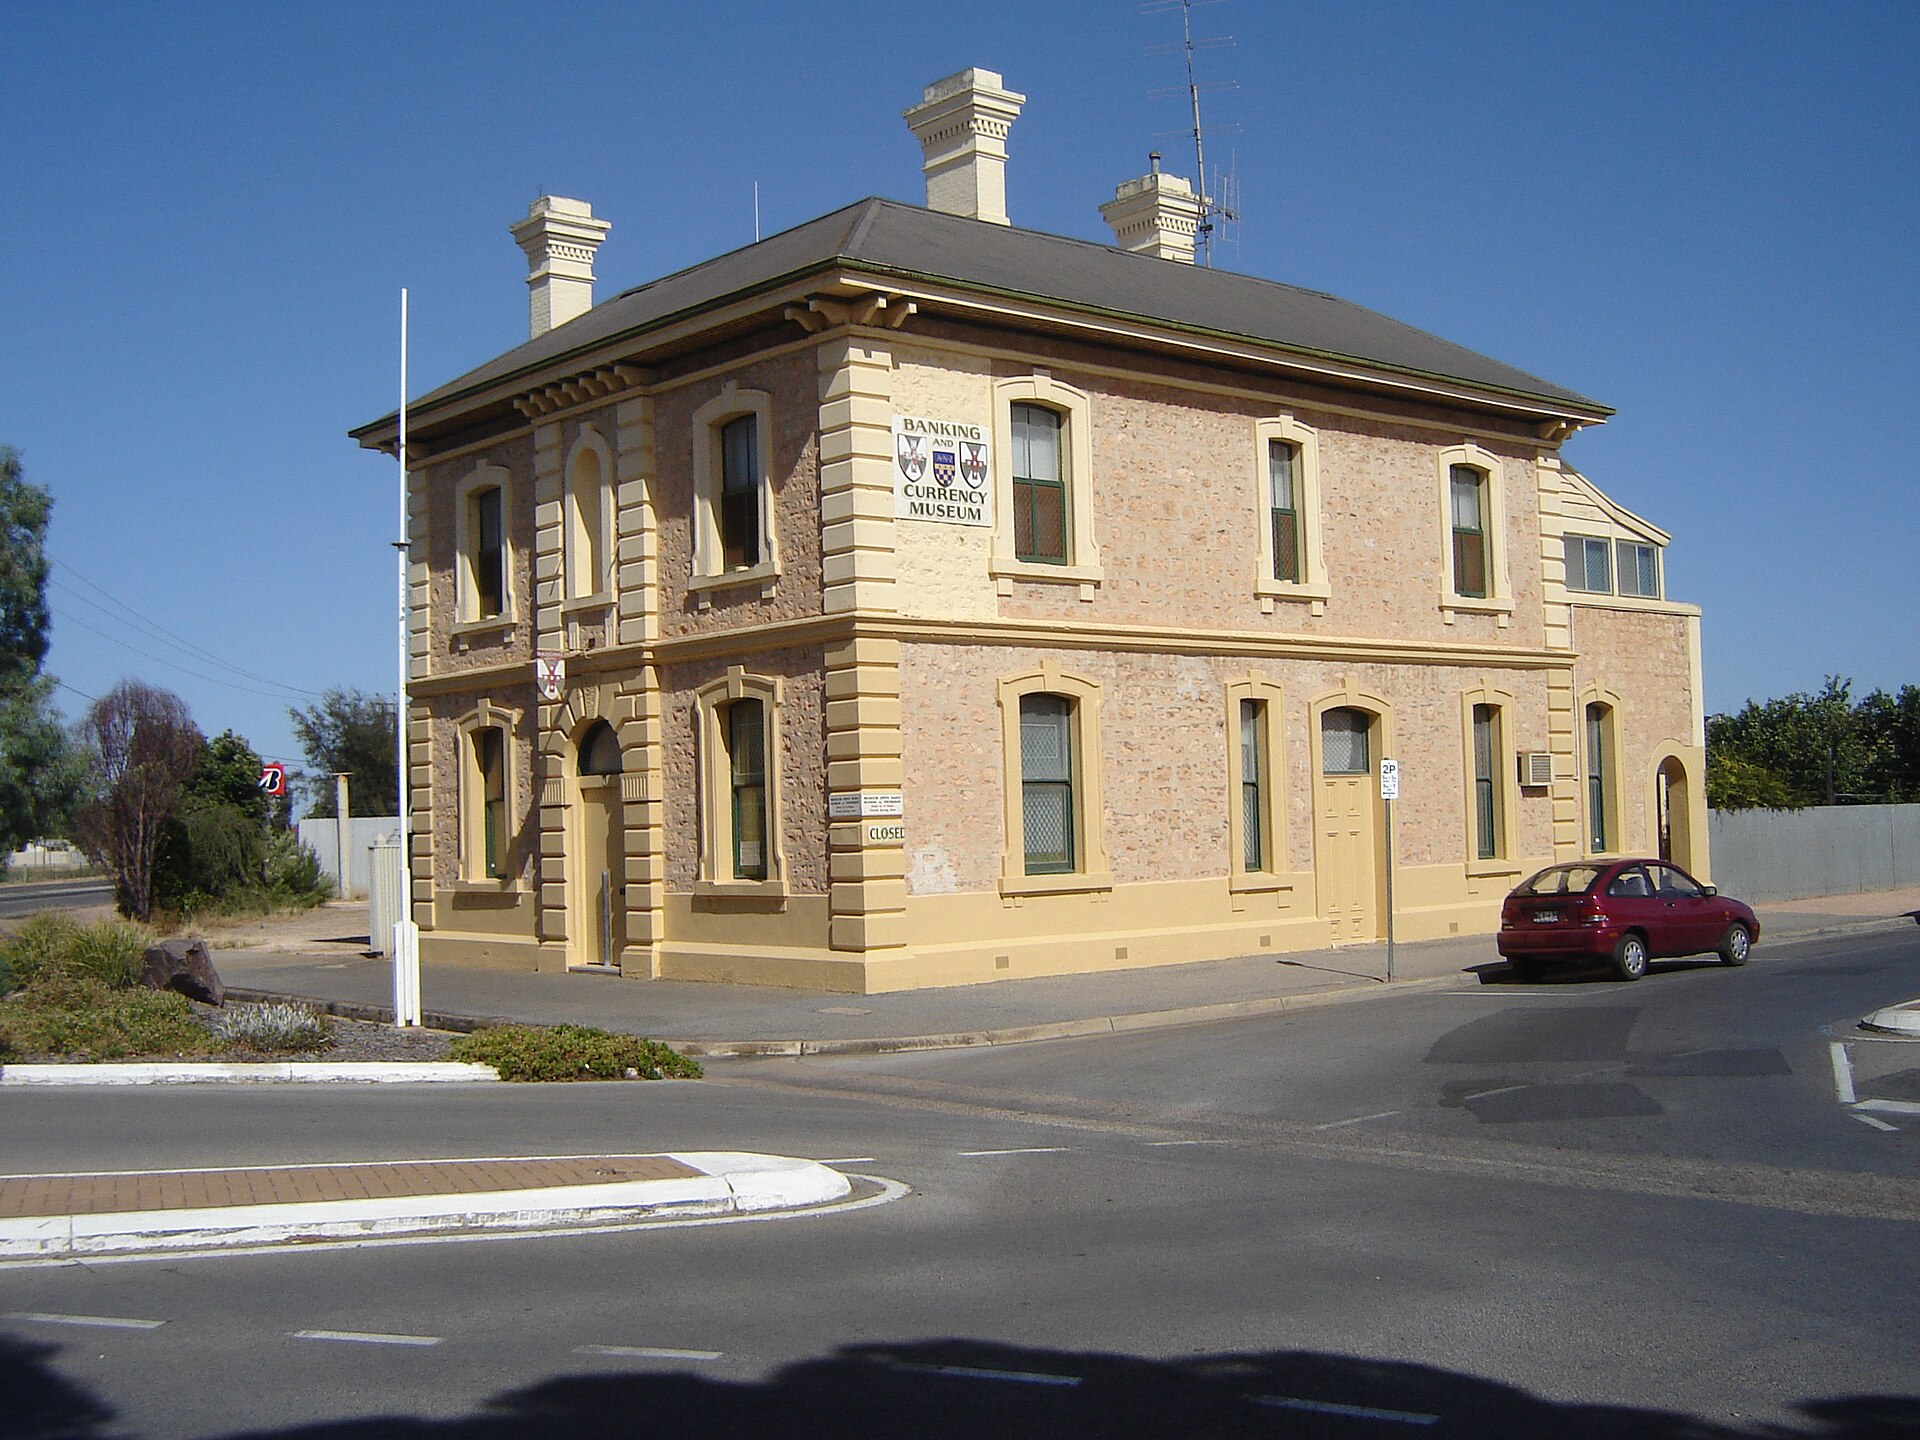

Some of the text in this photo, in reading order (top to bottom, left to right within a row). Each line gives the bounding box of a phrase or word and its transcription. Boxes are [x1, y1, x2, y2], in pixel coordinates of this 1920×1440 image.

[903, 418, 981, 440] BANKING
[932, 438, 954, 448] AND
[903, 484, 988, 505] CURRENCY
[909, 501, 981, 521] MUSEUM
[1382, 764, 1396, 774] 2P
[870, 827, 905, 840] CLOSED
